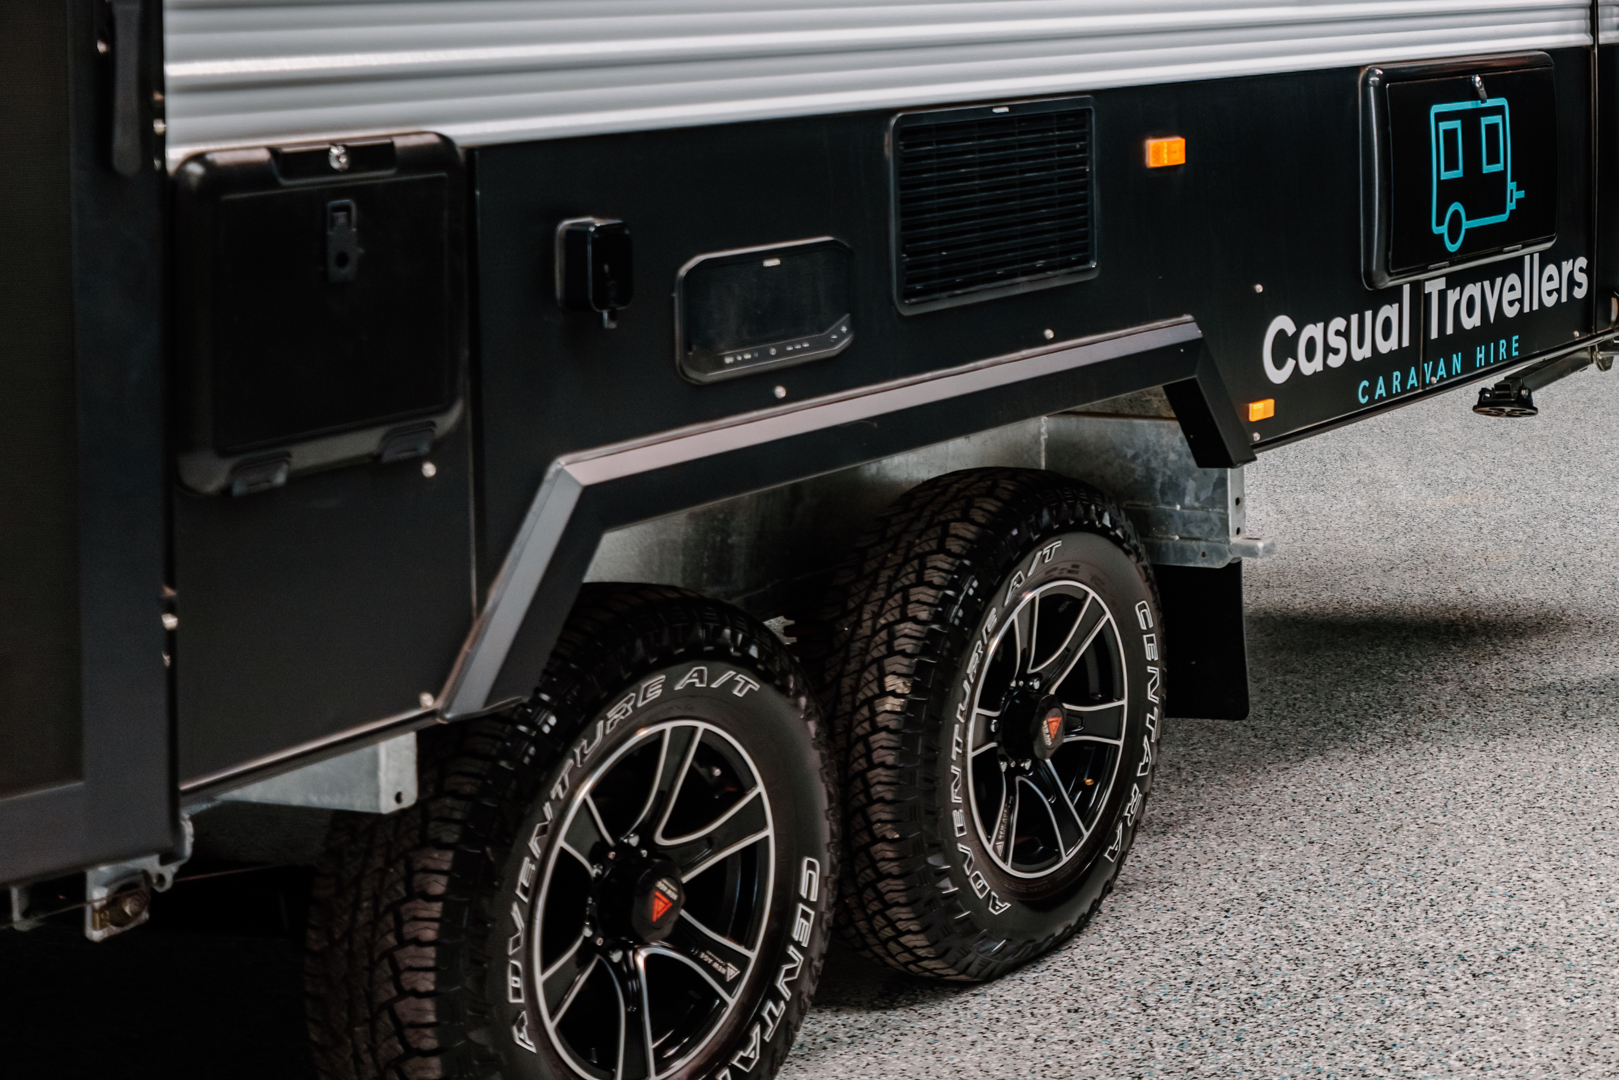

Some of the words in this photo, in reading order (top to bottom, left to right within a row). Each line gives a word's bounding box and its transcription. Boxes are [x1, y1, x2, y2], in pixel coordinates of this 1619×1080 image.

[1262, 284, 1411, 385] Casual
[1424, 253, 1589, 340] Travellers
[1357, 352, 1462, 405] CARAVAN
[1476, 335, 1520, 368] HIRE
[951, 607, 1011, 915] ADVENTURE
[1004, 540, 1062, 607] A/T
[1104, 600, 1160, 863] CENTARA
[508, 675, 666, 1054] ADVENTURE
[674, 666, 761, 698] A/T
[717, 856, 821, 1080] CENTA
